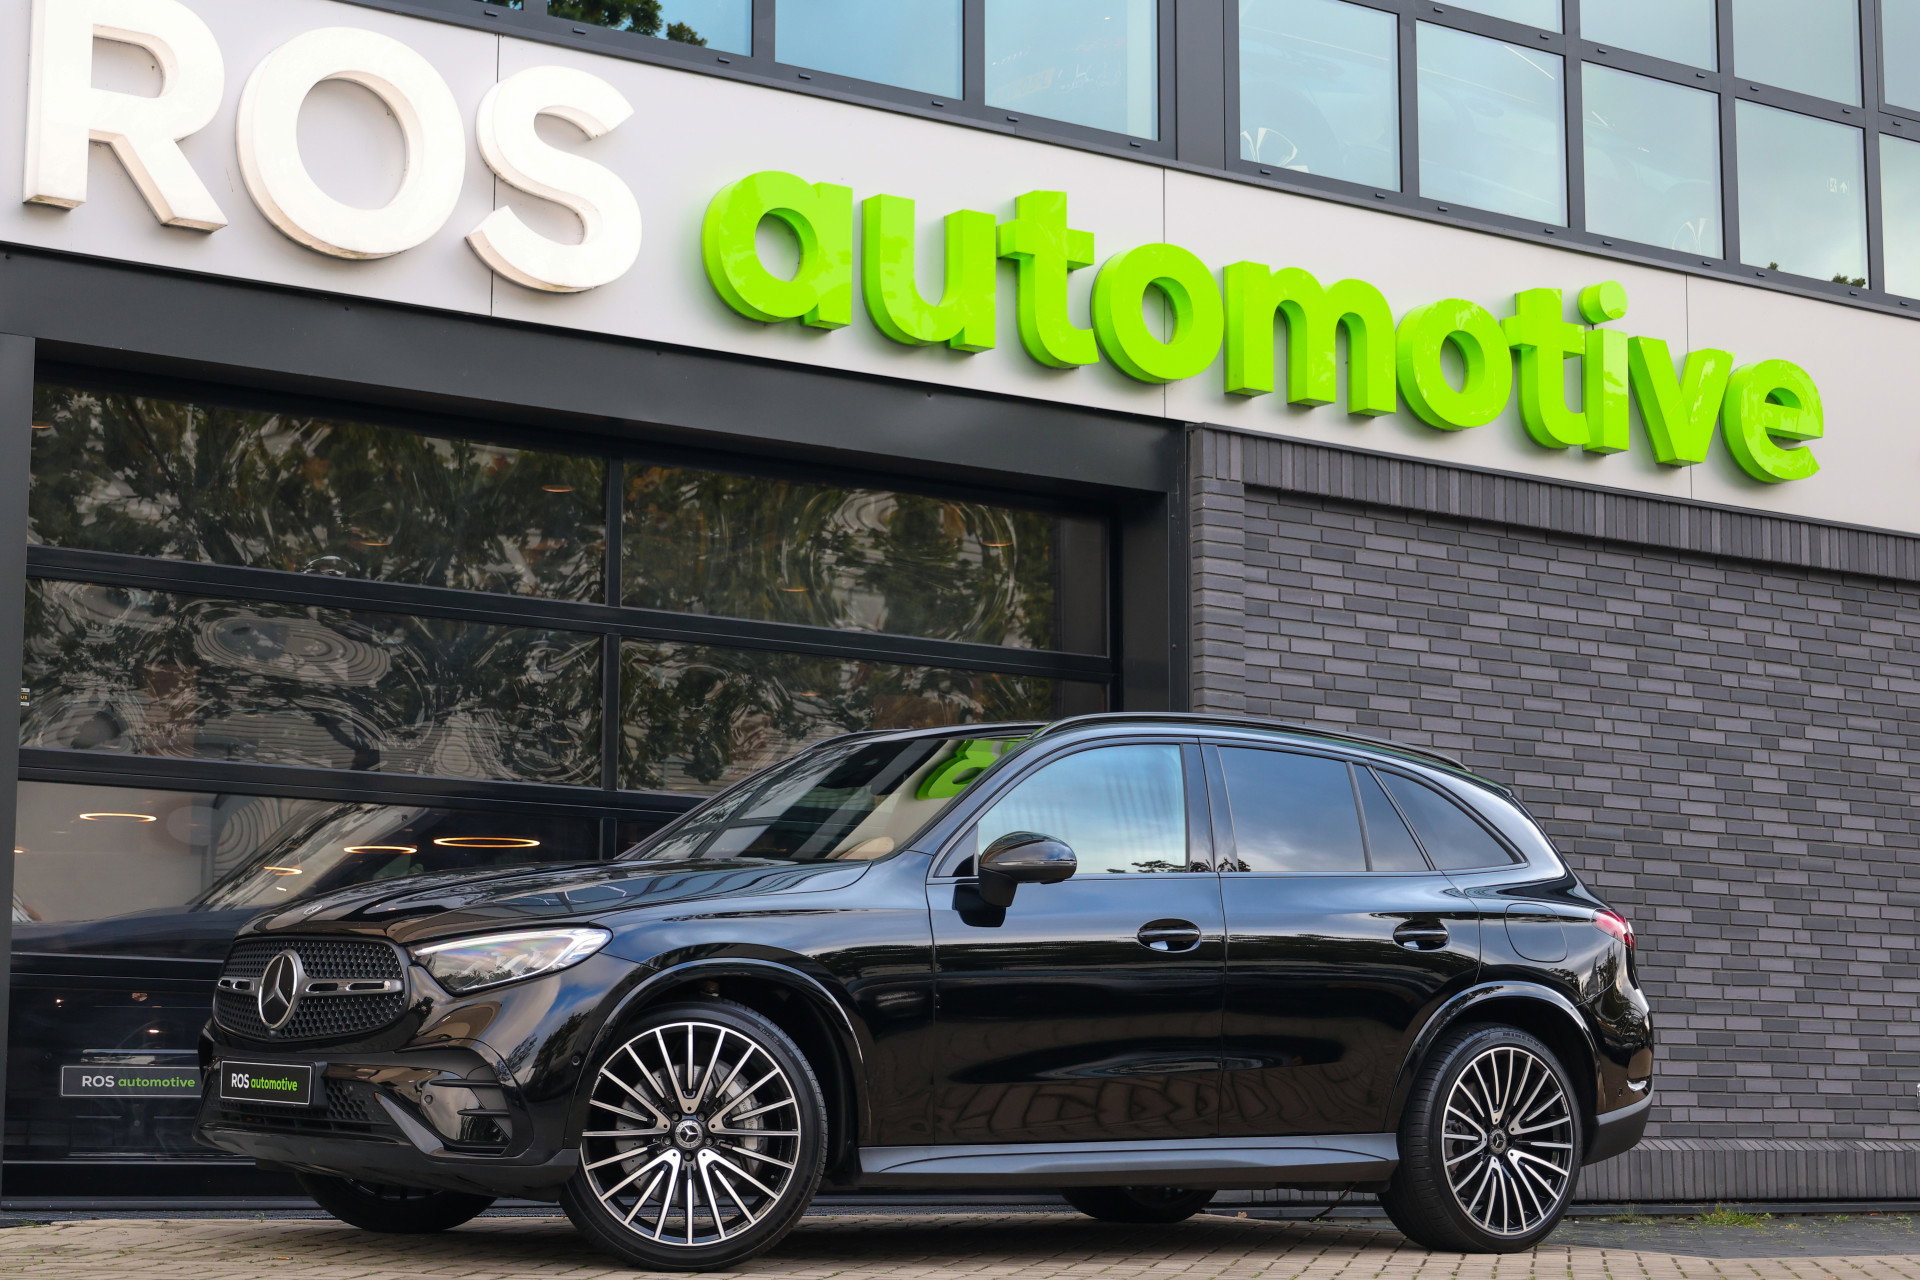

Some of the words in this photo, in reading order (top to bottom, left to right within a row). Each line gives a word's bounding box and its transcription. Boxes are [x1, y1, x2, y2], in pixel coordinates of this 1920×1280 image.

[23, 0, 642, 292] ROS
[701, 171, 1824, 484] automotive
[82, 1075, 115, 1087] ROS
[118, 1076, 196, 1087] automotive
[231, 1073, 250, 1088] ROS
[250, 1077, 298, 1091] automotive
